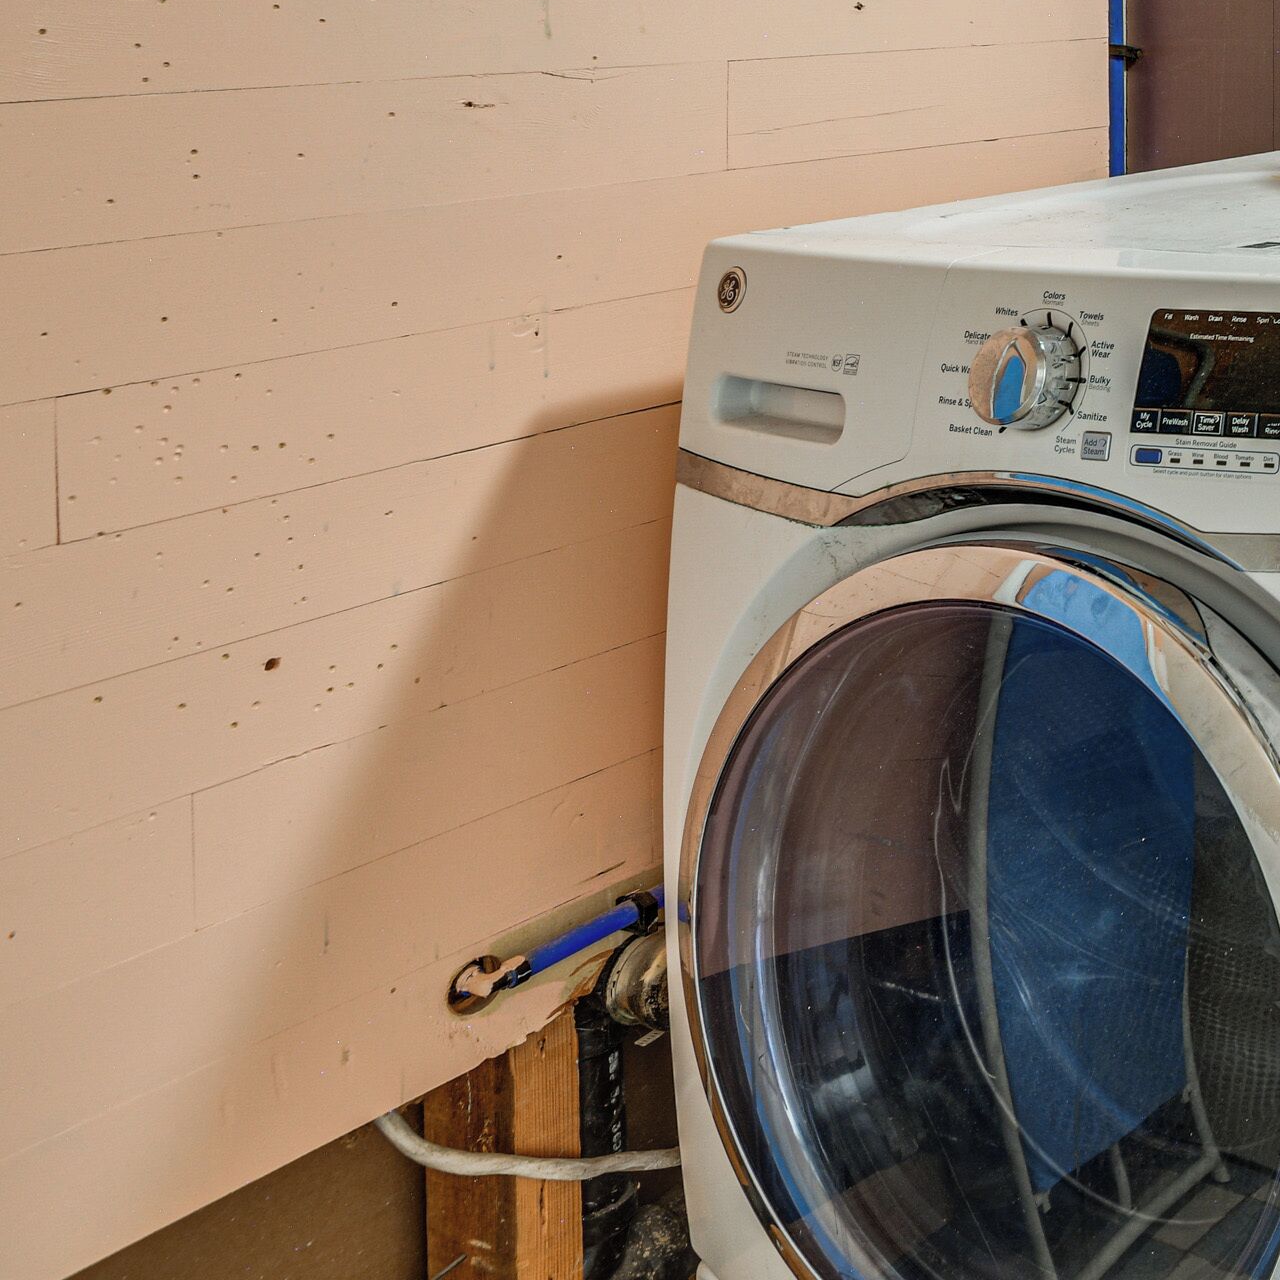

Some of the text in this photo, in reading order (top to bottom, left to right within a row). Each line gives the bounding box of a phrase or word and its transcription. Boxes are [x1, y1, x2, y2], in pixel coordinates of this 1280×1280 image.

[1043, 290, 1066, 300] Colors
[996, 307, 1018, 316] Whites
[1080, 311, 1104, 320] Towels
[1091, 340, 1114, 350] Active
[1092, 350, 1110, 358] Wear
[941, 363, 959, 373] Quick
[1090, 375, 1111, 386] Bulky
[939, 396, 962, 406] Rinse &
[1078, 410, 1108, 422] Sanitize
[1140, 412, 1150, 420] My
[1200, 416, 1214, 424] Time
[1136, 420, 1152, 428] Cycle
[1162, 418, 1188, 426] PreWash
[1232, 418, 1250, 426] Delay
[949, 424, 992, 436] Basket Clean
[1056, 436, 1076, 444] Steam
[1084, 438, 1097, 446] Add
[1192, 440, 1218, 448] Removal
[1054, 444, 1075, 454] Cycles
[1083, 446, 1104, 455] Steam
